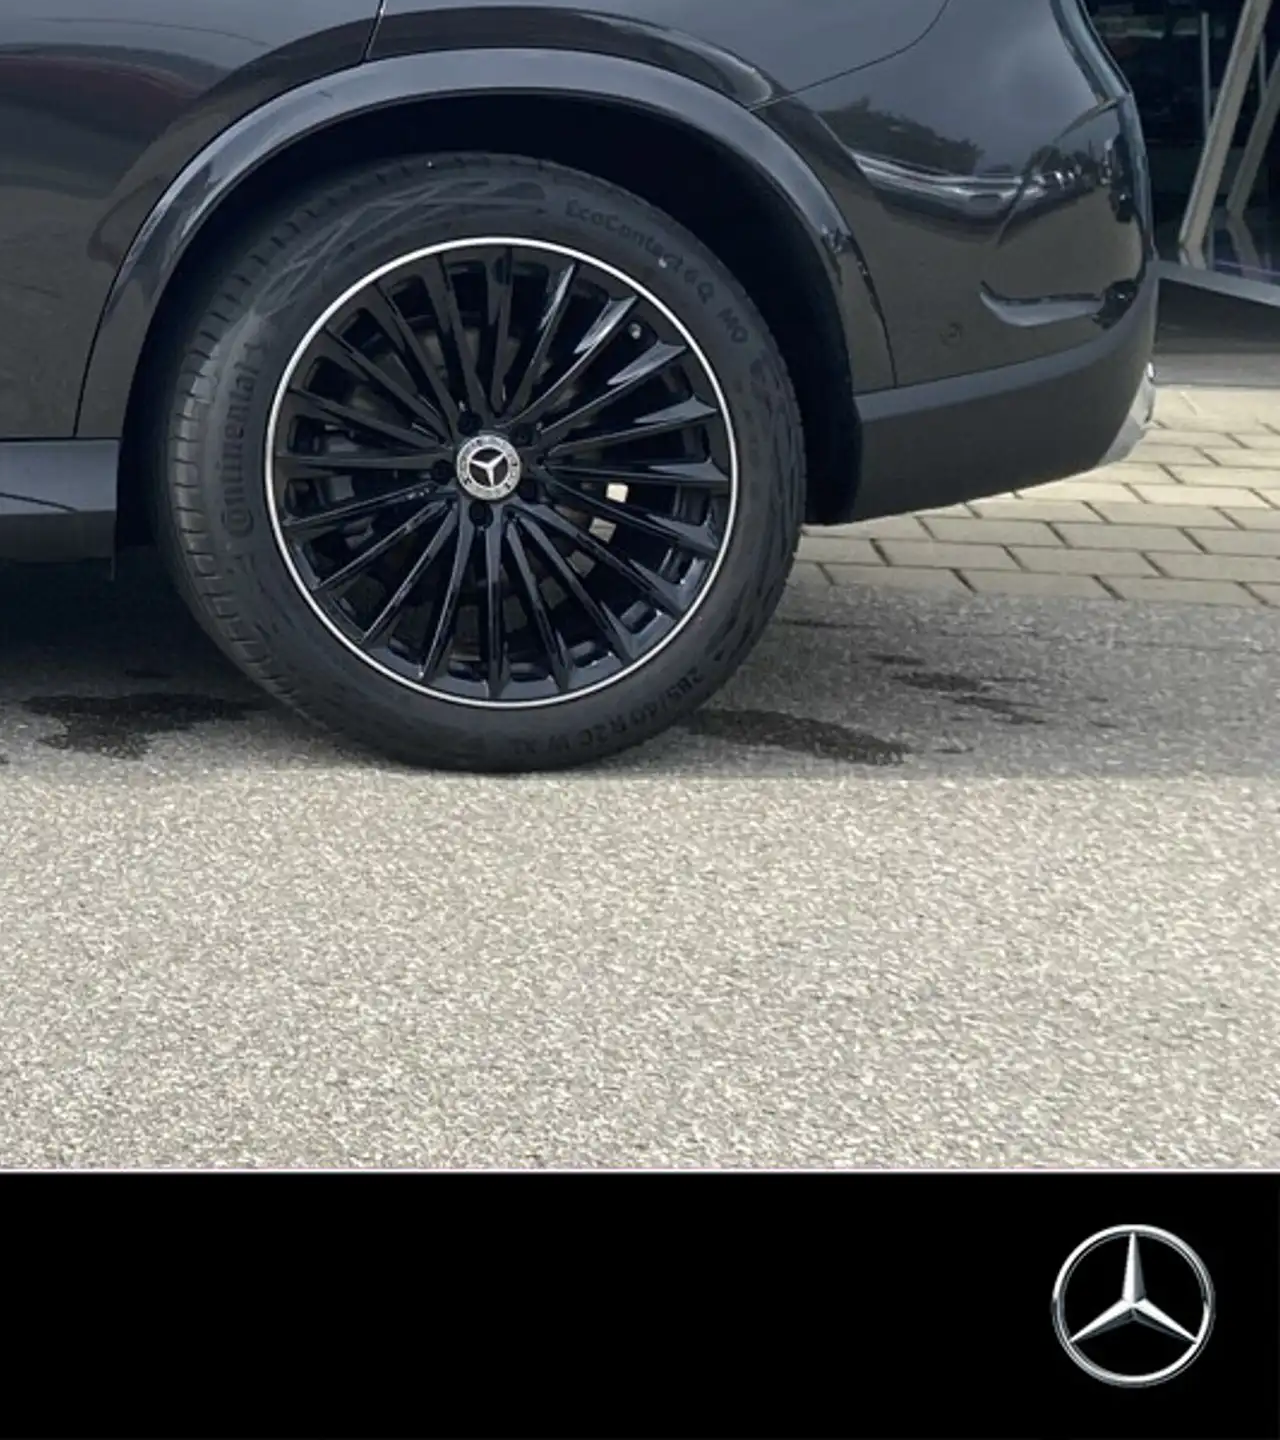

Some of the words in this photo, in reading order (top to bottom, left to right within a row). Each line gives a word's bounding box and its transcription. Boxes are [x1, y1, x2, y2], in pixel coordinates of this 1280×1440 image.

[564, 198, 684, 274] EcoContact
[717, 306, 748, 343] MO
[219, 362, 261, 538] Continental
